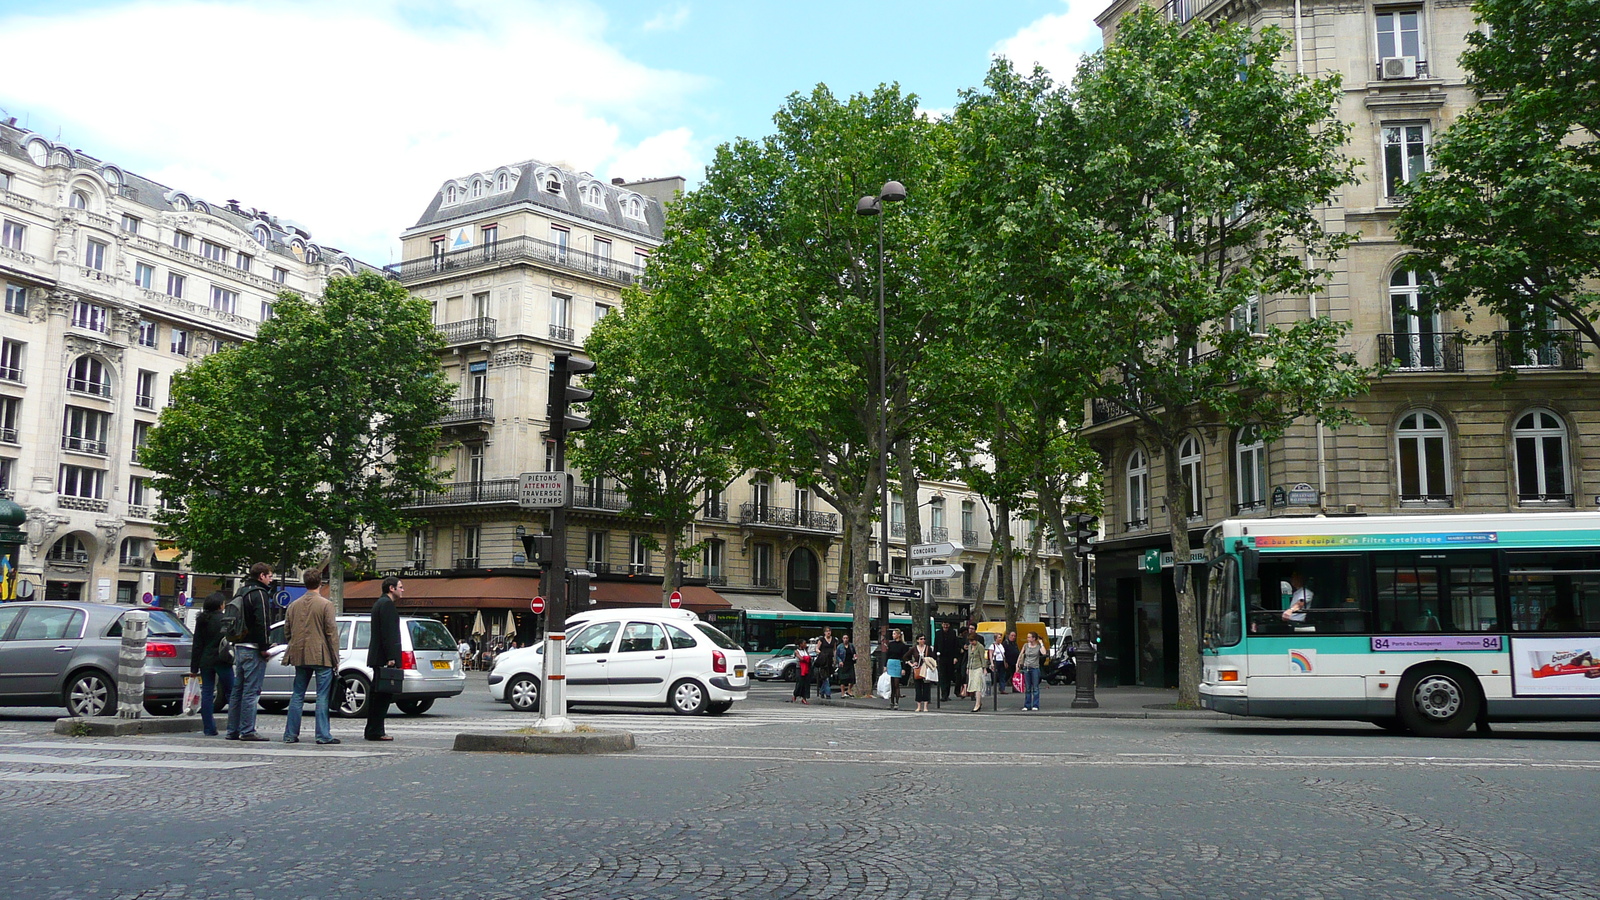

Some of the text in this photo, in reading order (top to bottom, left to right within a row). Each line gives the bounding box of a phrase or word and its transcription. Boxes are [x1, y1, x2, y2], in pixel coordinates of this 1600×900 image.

[1390, 536, 1441, 544] catalytique
[1374, 638, 1390, 649] 84
[1482, 637, 1498, 648] 84
[1551, 652, 1577, 662] bueno
